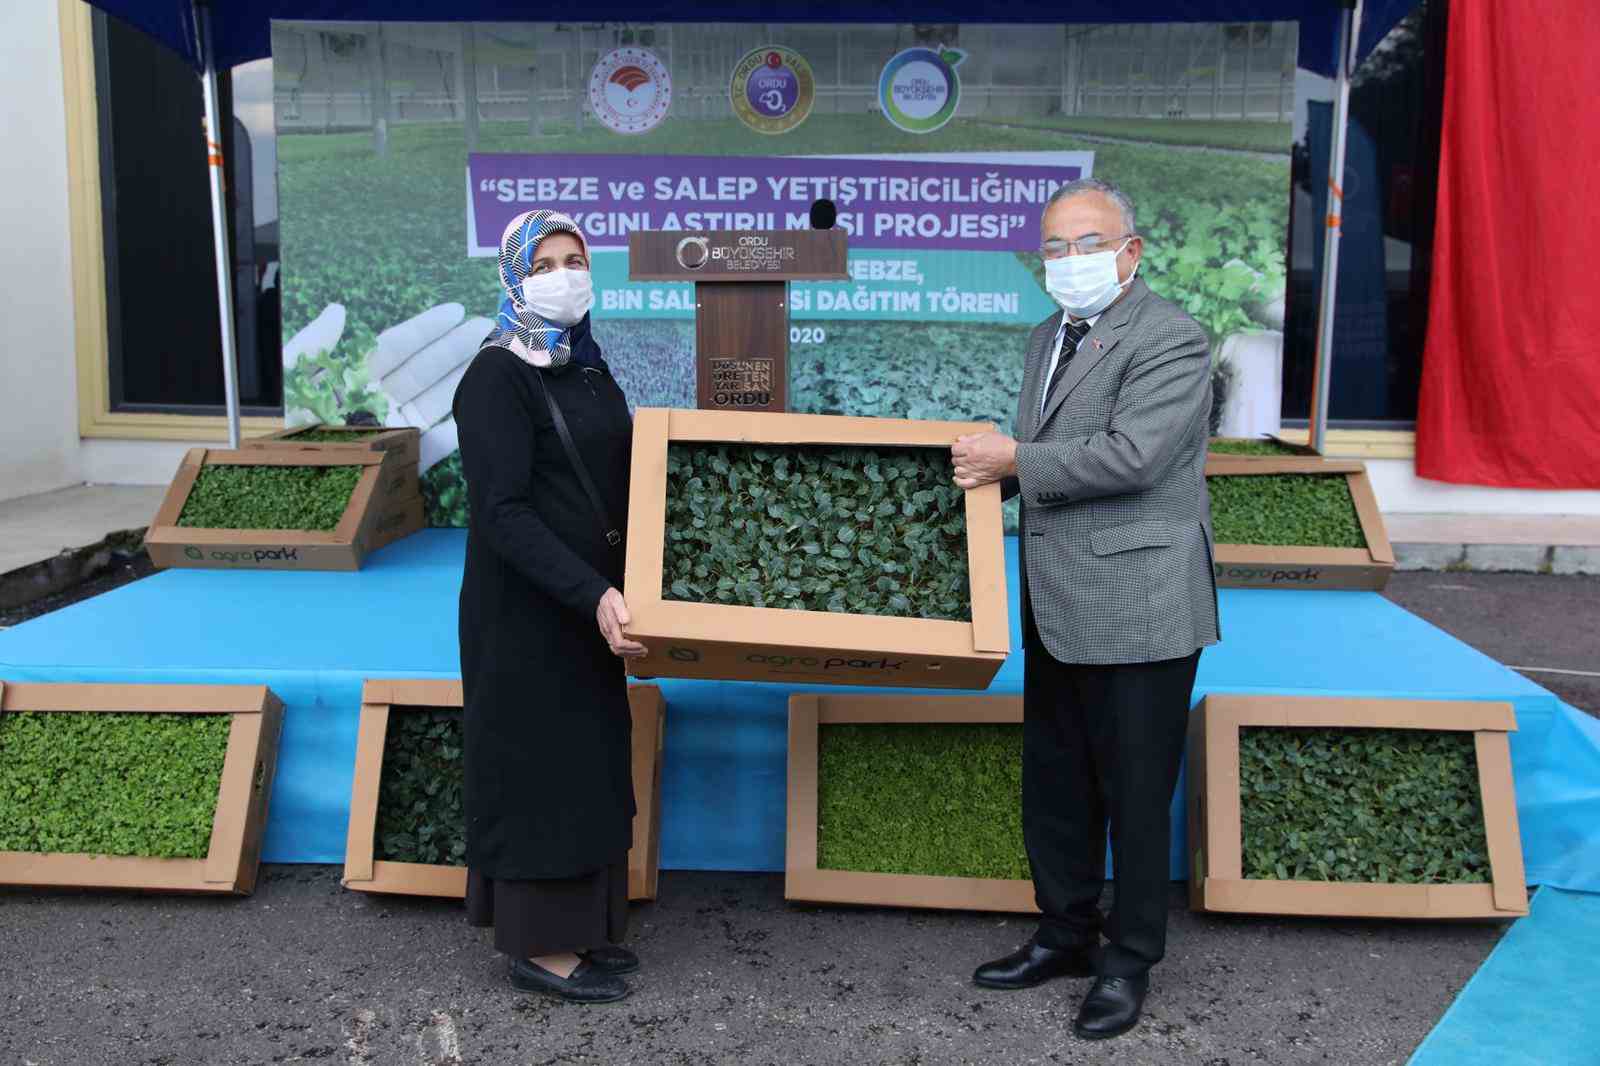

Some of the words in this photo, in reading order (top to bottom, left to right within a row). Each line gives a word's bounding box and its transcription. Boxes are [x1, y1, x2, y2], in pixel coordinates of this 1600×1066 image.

[608, 180, 645, 200] ve
[654, 176, 758, 201] SALEP
[738, 236, 769, 247] ORDU
[848, 260, 924, 285] EBZE,
[816, 285, 920, 313] DAĞITIM
[926, 287, 1019, 314] TÖRENİ
[714, 392, 769, 405] ORDU
